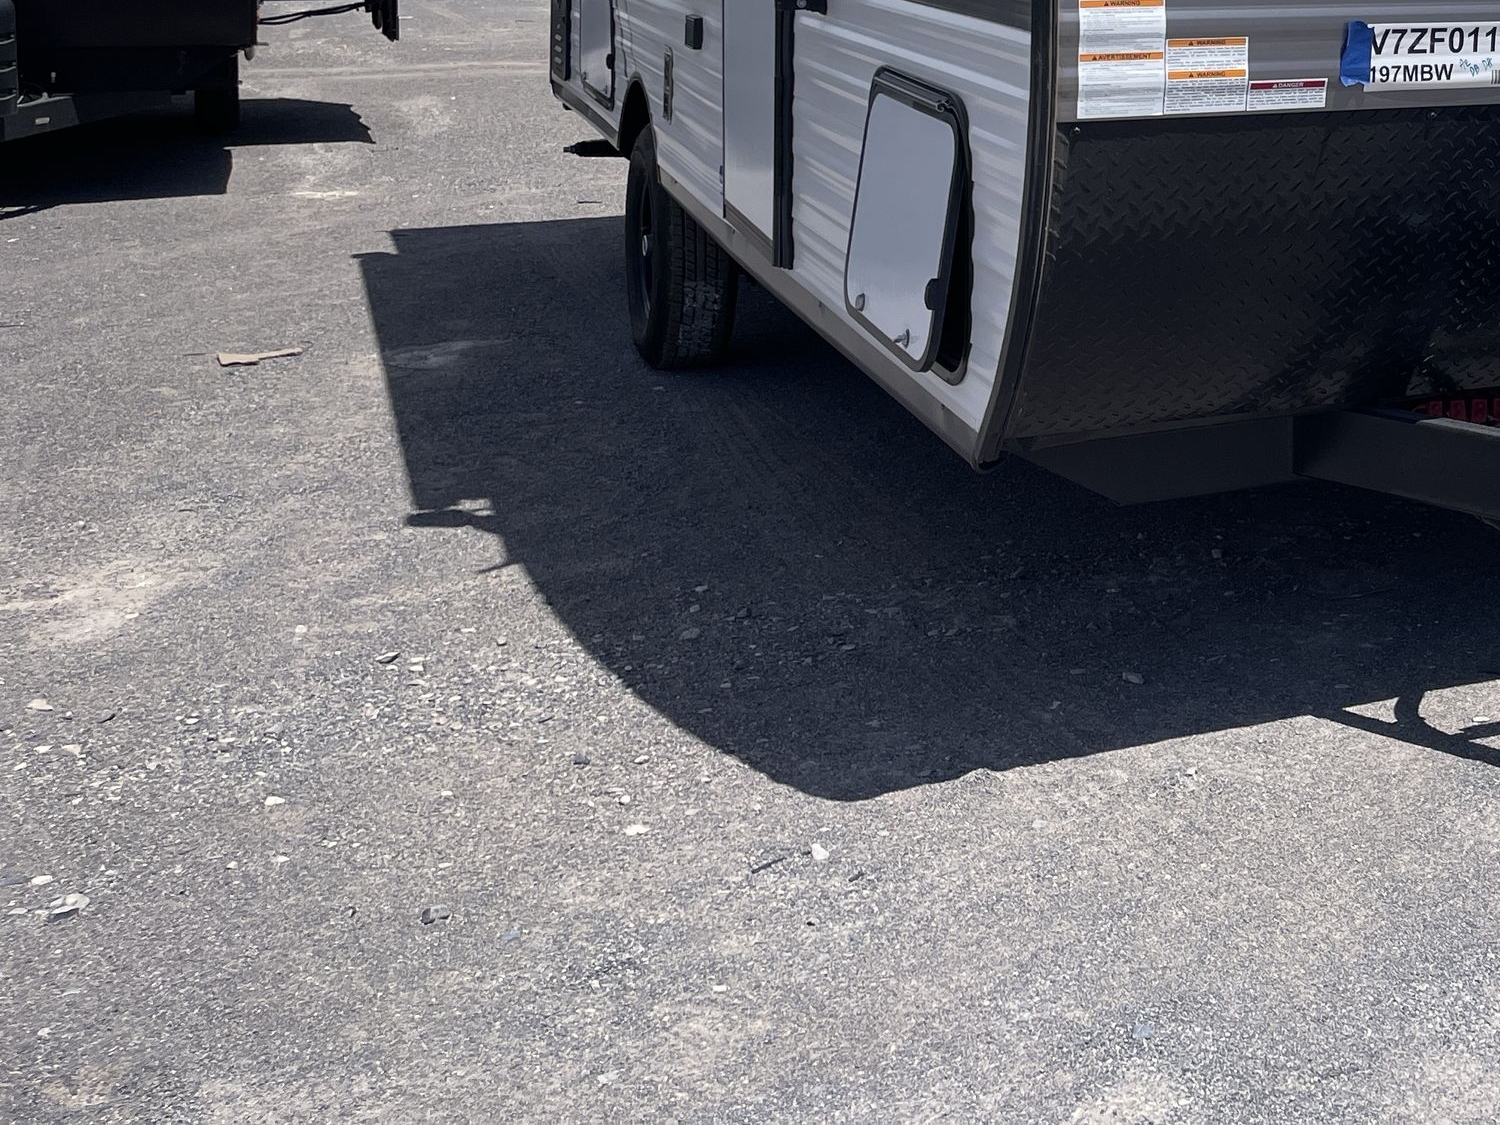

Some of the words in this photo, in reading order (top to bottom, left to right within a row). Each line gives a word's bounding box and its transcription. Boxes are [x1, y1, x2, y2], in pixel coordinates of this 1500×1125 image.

[1110, 0, 1141, 7] WARNING
[1196, 70, 1226, 78] WARNING
[1370, 63, 1454, 83] 197MBW
